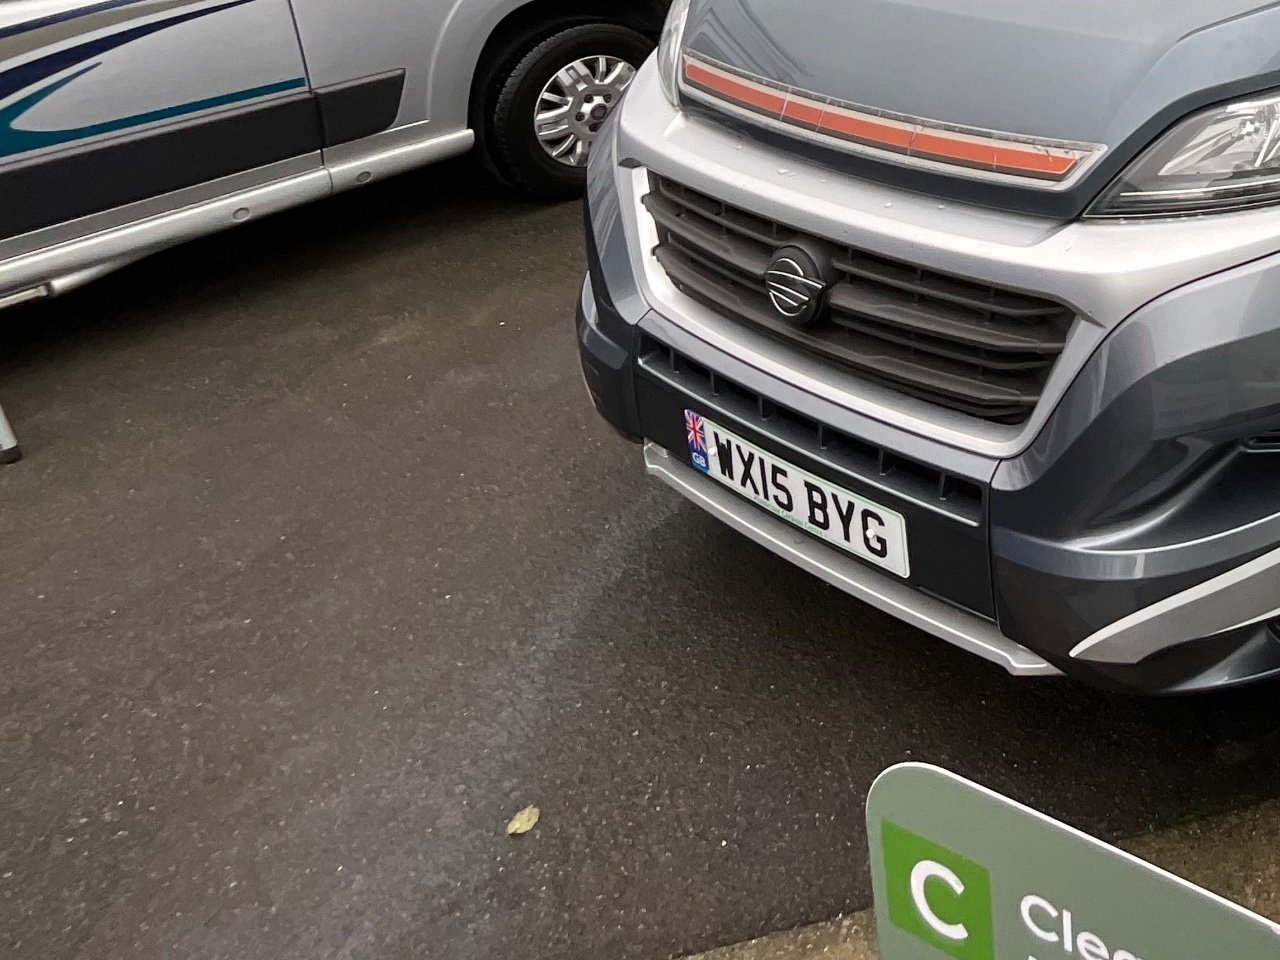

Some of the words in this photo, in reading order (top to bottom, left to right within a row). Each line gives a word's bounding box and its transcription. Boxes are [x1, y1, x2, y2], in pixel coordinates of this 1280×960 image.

[691, 452, 707, 468] GB
[713, 431, 794, 512] WX15
[804, 480, 888, 558] BYG
[1020, 894, 1146, 960] Cle
